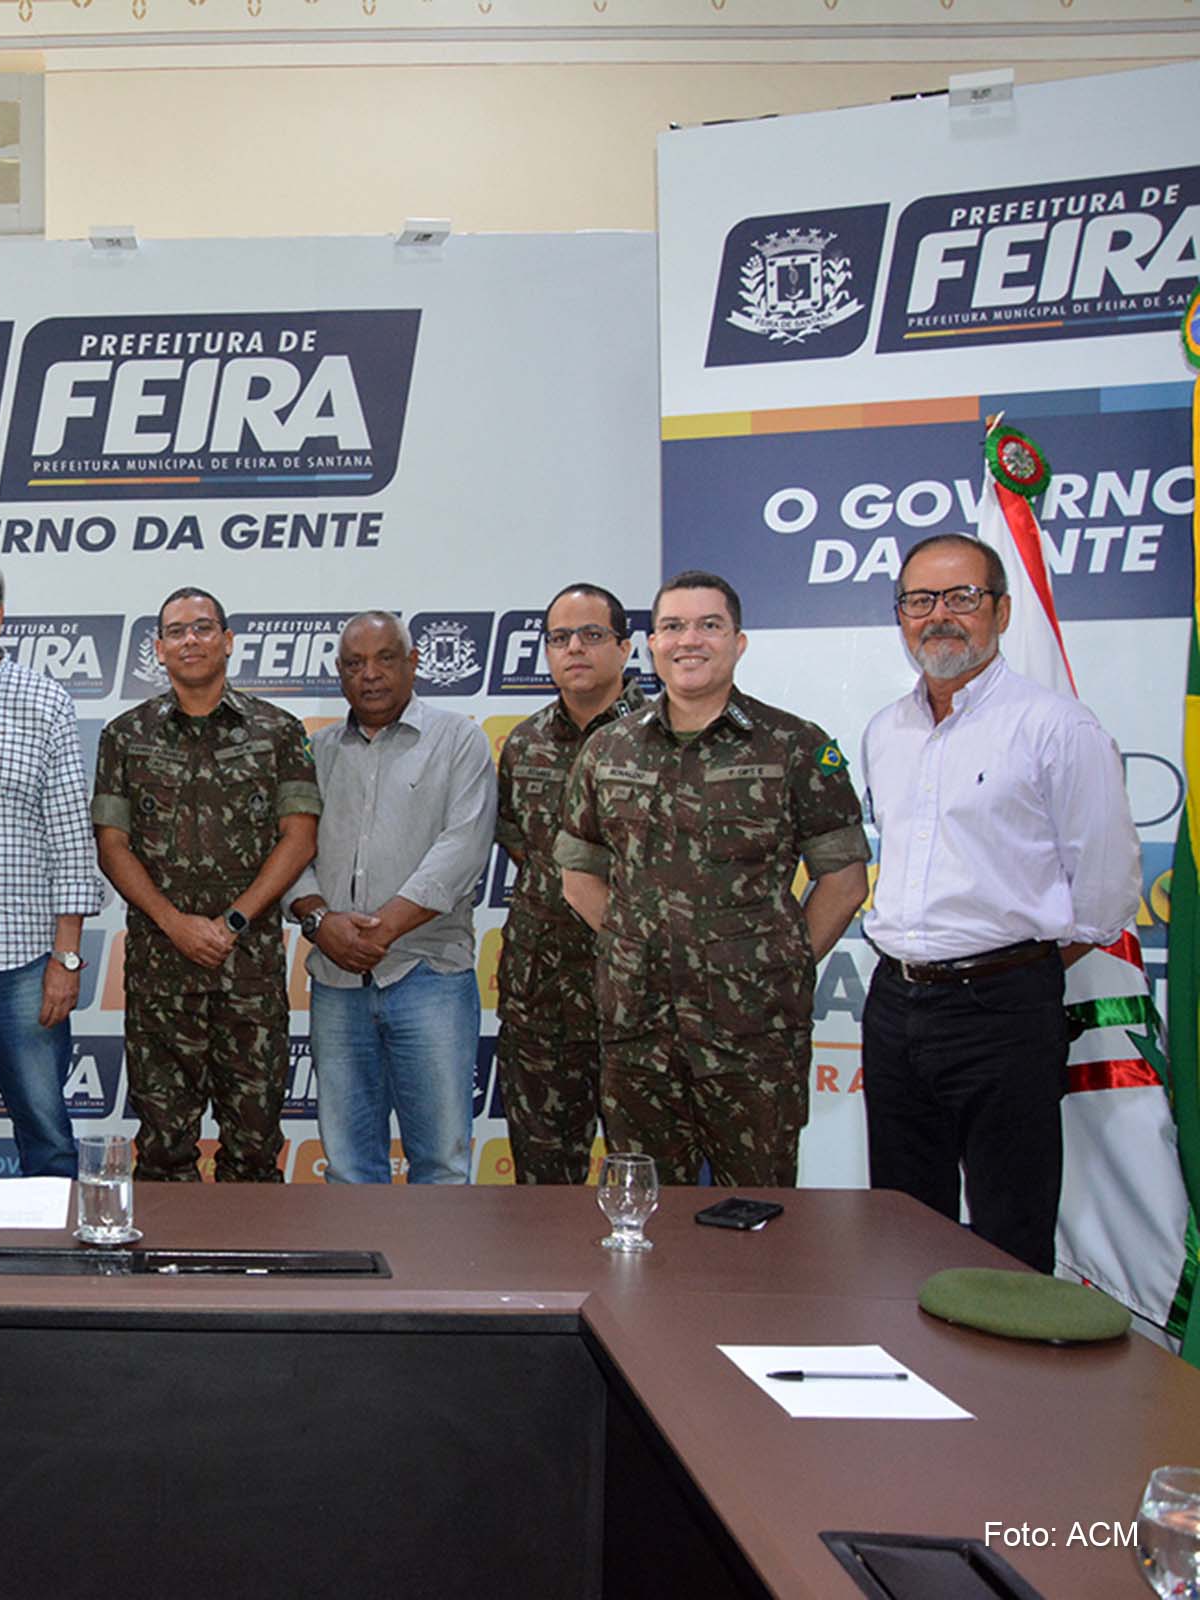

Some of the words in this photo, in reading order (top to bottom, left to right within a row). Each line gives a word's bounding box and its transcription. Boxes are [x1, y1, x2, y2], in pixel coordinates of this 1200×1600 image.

[950, 190, 1126, 227] PREFEITURA
[1140, 184, 1180, 208] DE
[906, 204, 1200, 314] FEIRA
[907, 311, 987, 328] PREFEITURA
[993, 305, 1066, 321] MUNICIPAL
[1072, 303, 1090, 314] DE
[1096, 299, 1137, 312] FEIRA
[1143, 297, 1160, 308] DE
[80, 331, 265, 356] PREFEITURA
[278, 330, 318, 352] DE
[31, 355, 373, 456] FEIRA
[33, 459, 121, 473] PREFEITURA
[126, 457, 205, 470] MUNICIPAL
[211, 457, 230, 469] DE
[235, 456, 277, 469] FEIRA
[283, 455, 301, 468] DE
[307, 455, 373, 467] SANTANA
[763, 487, 818, 534] O
[840, 466, 1196, 530] GOVRNO
[132, 514, 205, 551] DA
[220, 511, 384, 550] GENTE
[808, 537, 902, 584] DA
[61, 623, 80, 634] DE
[247, 620, 331, 632] PREFEITURA
[225, 633, 339, 678] FEIR
